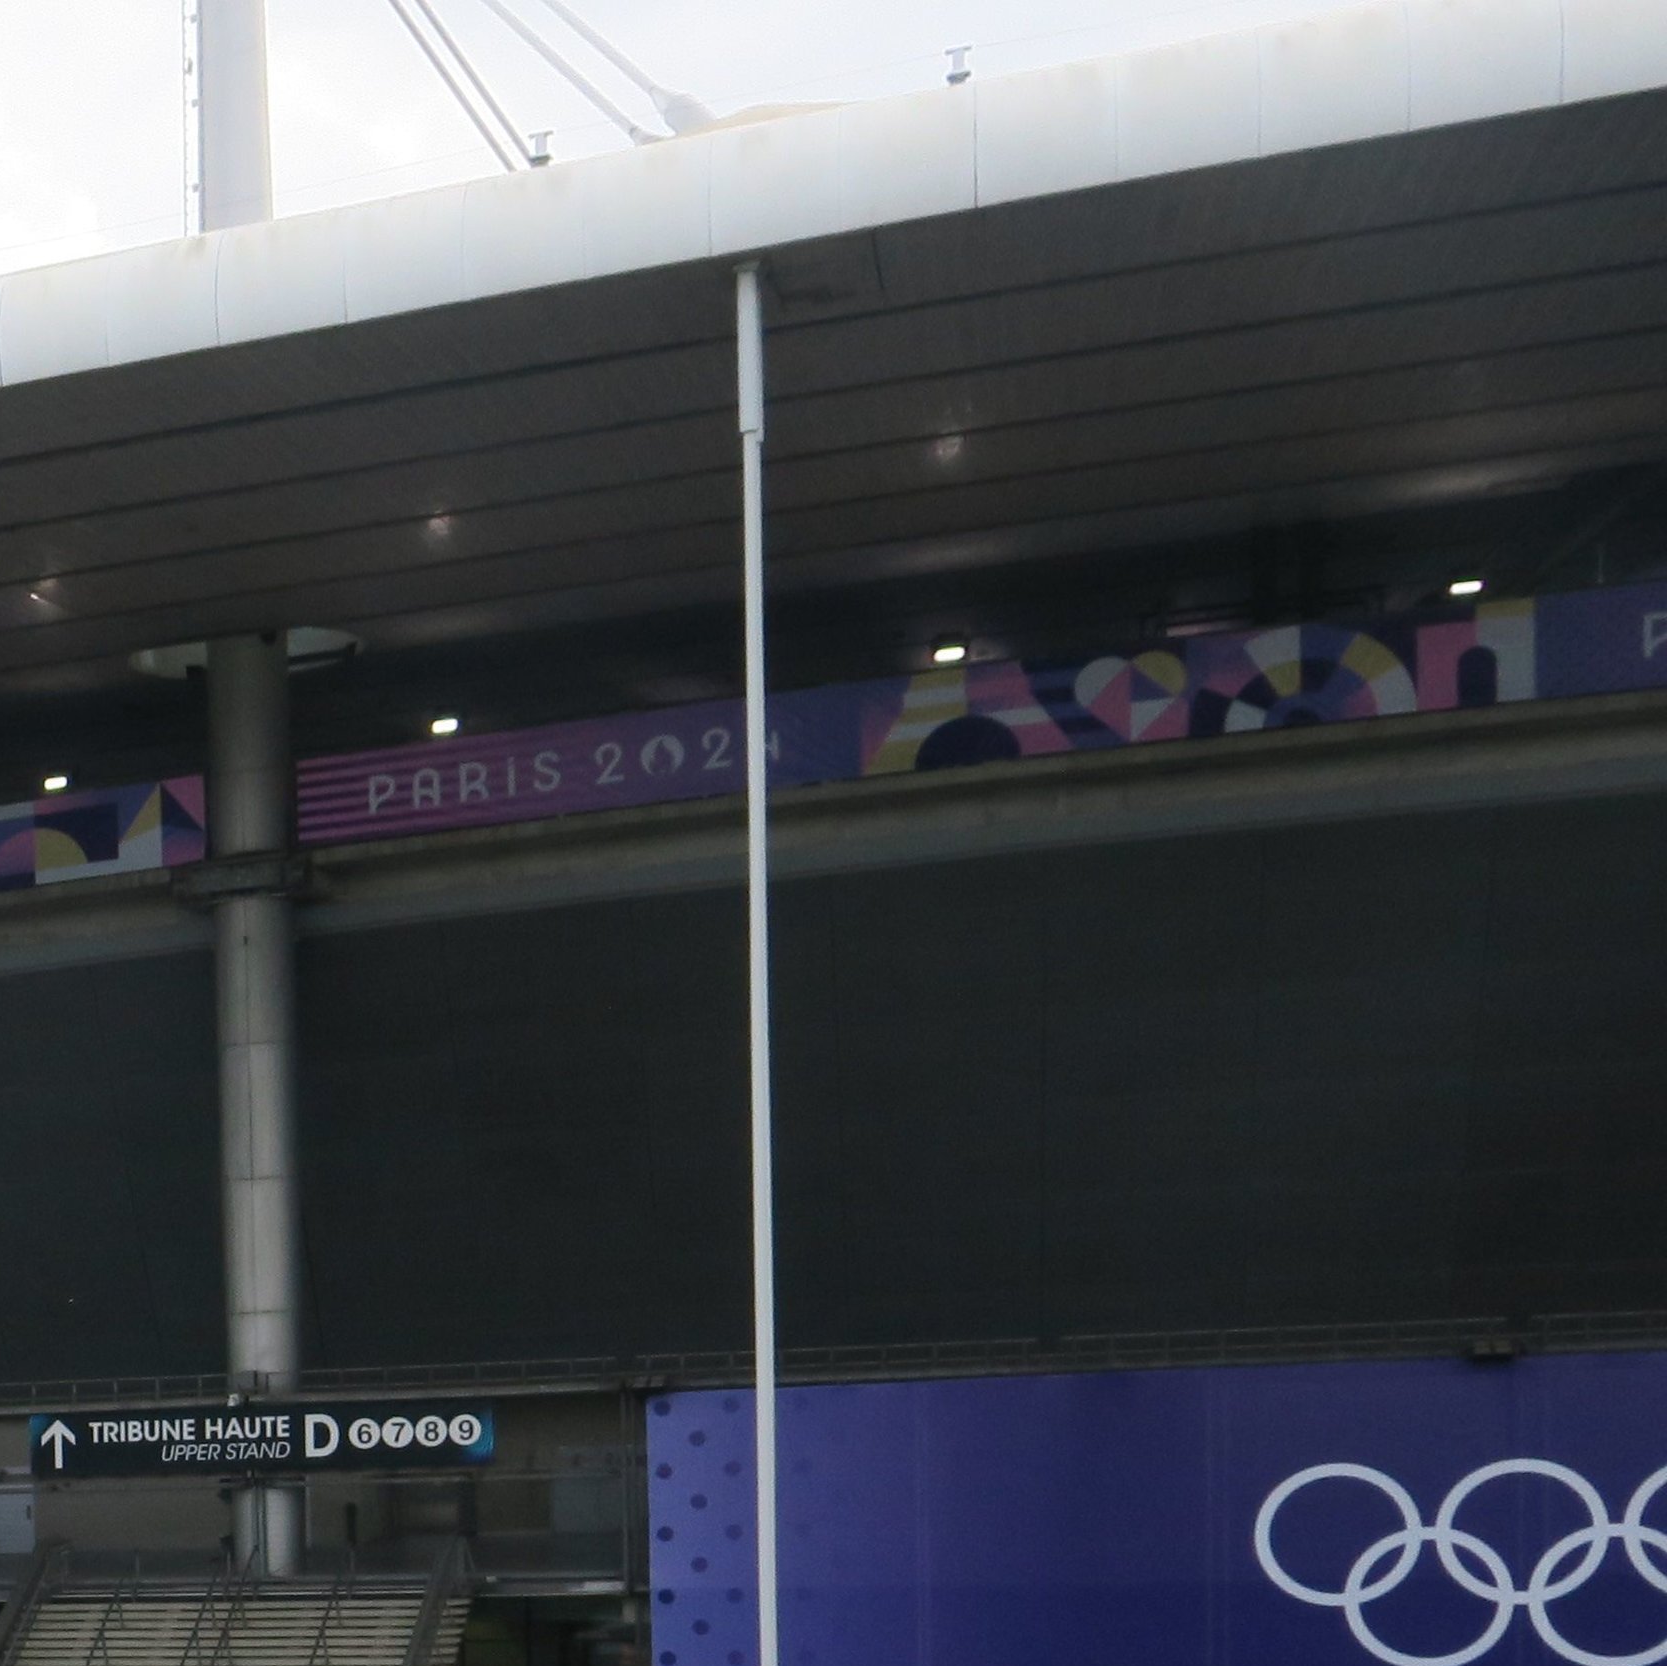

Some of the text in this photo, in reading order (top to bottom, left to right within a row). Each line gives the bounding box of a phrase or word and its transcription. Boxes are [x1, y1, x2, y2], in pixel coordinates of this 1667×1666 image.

[88, 1420, 195, 1444] TRIBUNE
[204, 1415, 291, 1440] HAUTE
[304, 1413, 339, 1458] D
[388, 1419, 408, 1445] 7
[161, 1441, 290, 1462] UPPER STAND
